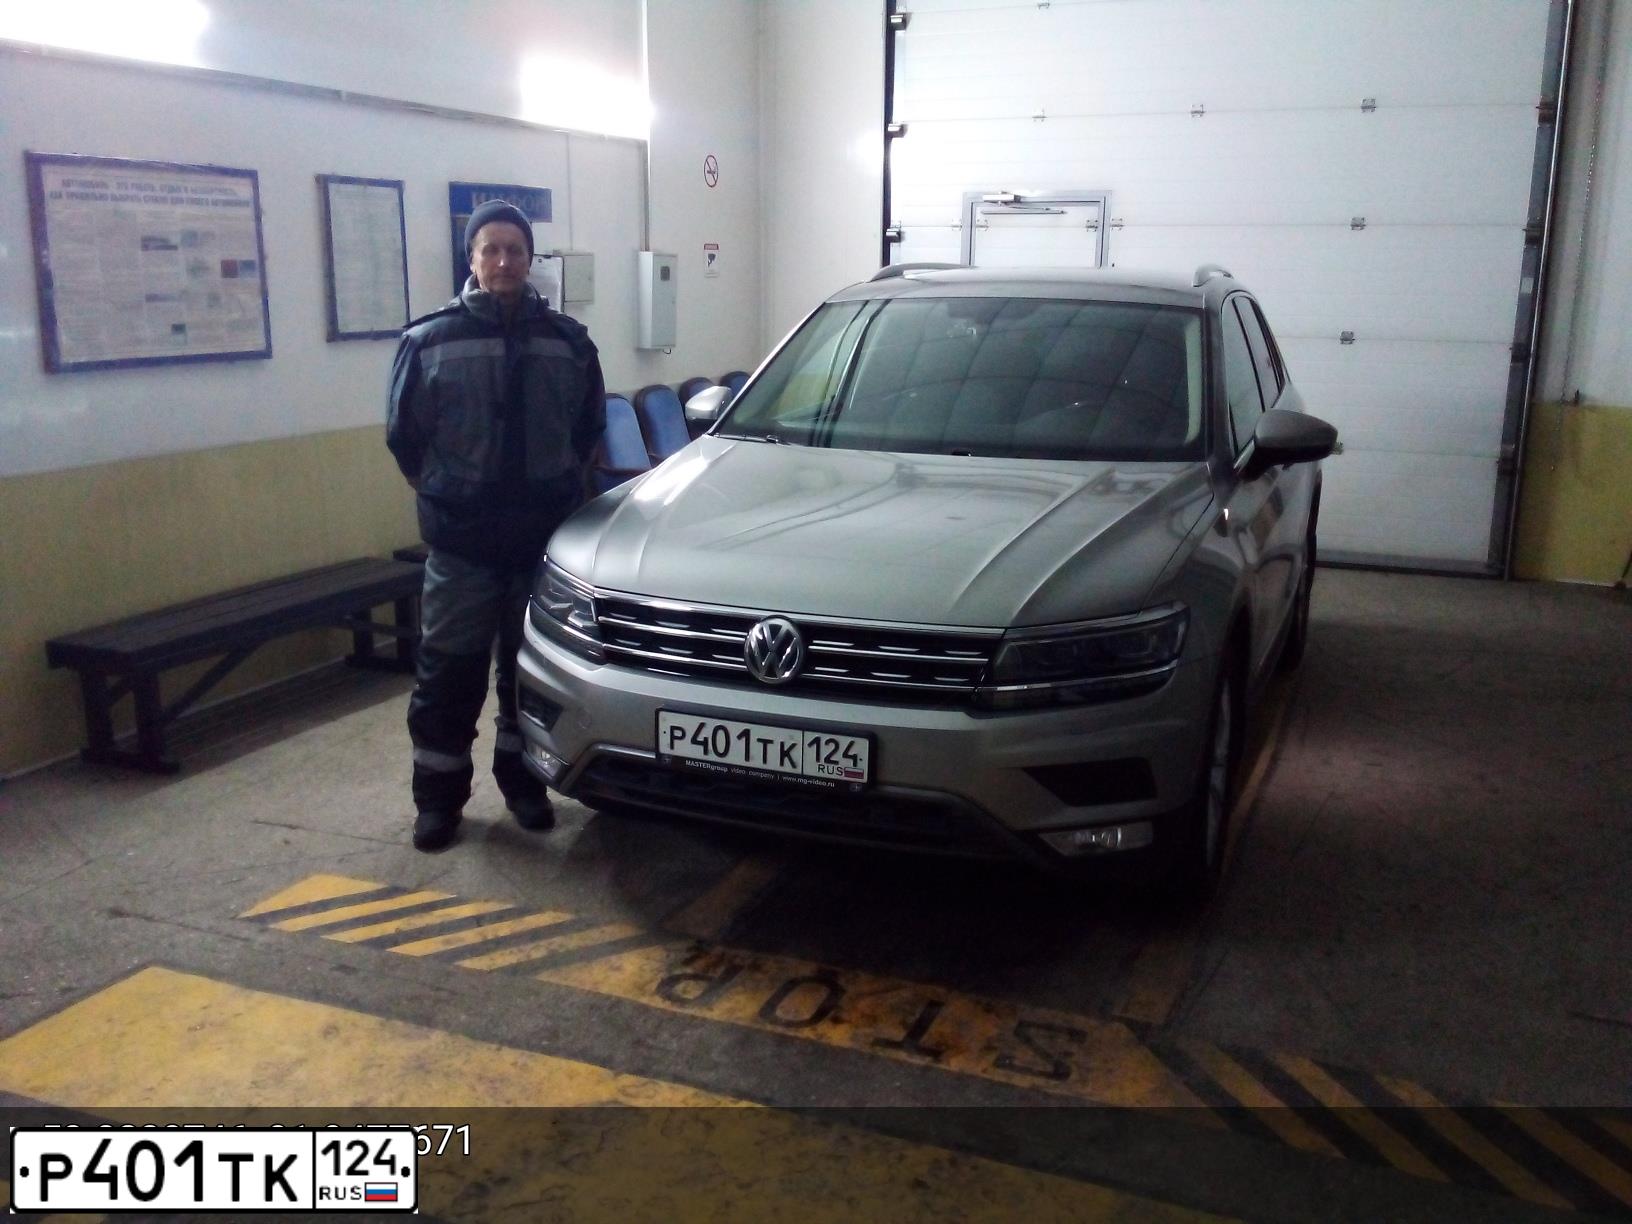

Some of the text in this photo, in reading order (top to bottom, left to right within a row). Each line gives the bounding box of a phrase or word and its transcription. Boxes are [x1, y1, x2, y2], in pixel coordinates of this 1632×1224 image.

[807, 736, 858, 767] 124
[817, 763, 844, 776] RUS
[655, 961, 1089, 1082] STOP
